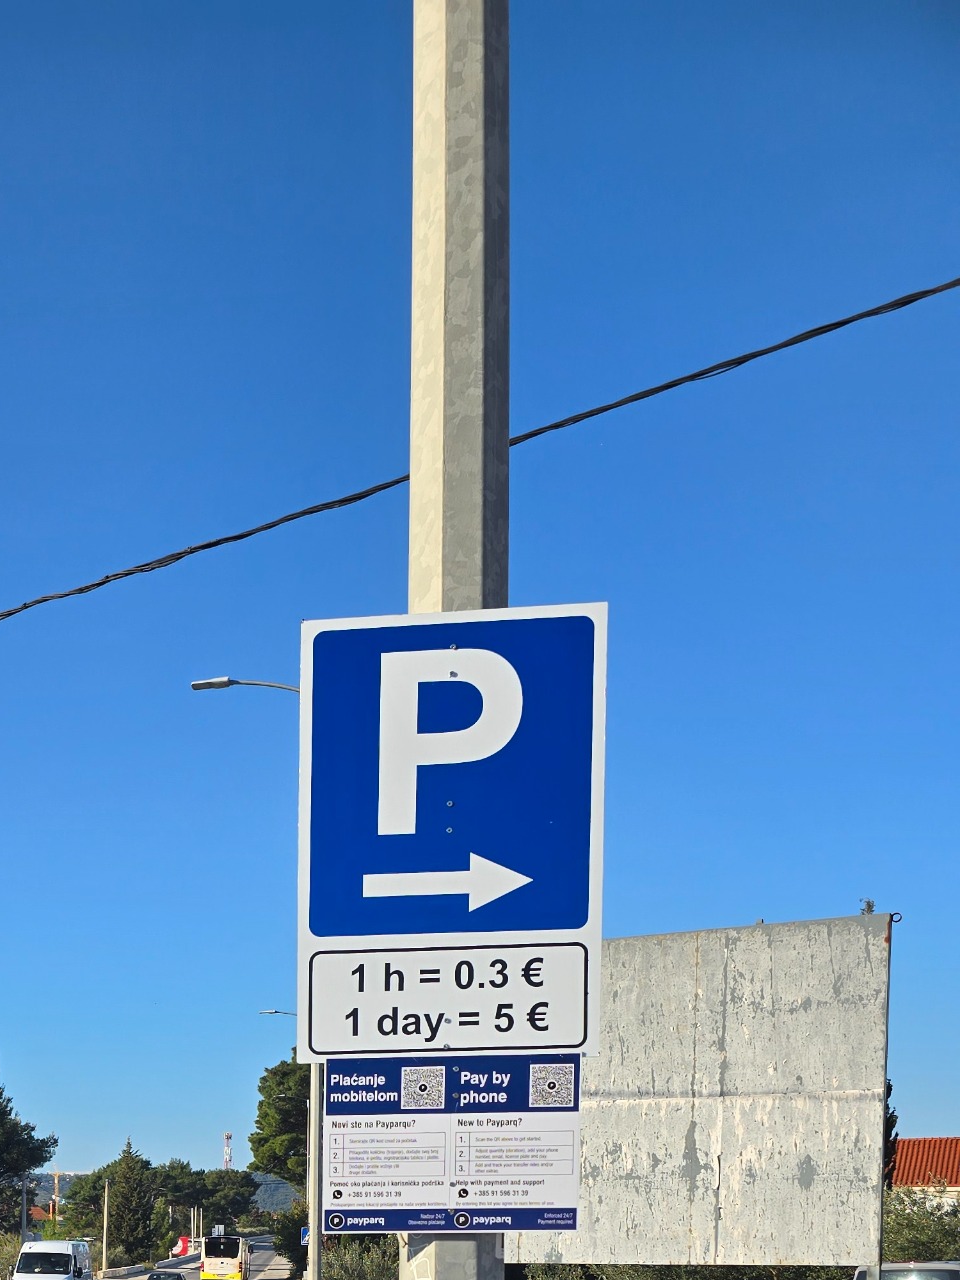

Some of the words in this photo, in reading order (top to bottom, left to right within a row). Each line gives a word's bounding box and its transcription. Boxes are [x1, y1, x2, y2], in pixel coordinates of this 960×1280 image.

[378, 648, 524, 835] P
[352, 964, 365, 992] 1
[385, 962, 404, 992] h
[420, 968, 440, 984] =
[454, 959, 508, 990] 0.3
[521, 958, 544, 987] €
[345, 1007, 359, 1036] 1
[377, 1006, 445, 1042] day
[458, 1012, 480, 1026] =
[494, 1004, 514, 1032] 5
[526, 1002, 549, 1031] €
[330, 1074, 386, 1088] Plaćanje
[460, 1072, 488, 1088] Pay
[492, 1071, 510, 1086] by
[330, 1090, 398, 1102] mobitelom
[460, 1090, 508, 1106] phone
[332, 1120, 348, 1128] Novi
[351, 1120, 362, 1128] ste
[376, 1120, 416, 1130] Payparqu?
[458, 1118, 474, 1126] New
[476, 1118, 484, 1126] to
[486, 1118, 522, 1128] Payparq?
[347, 1217, 385, 1226] payparq
[473, 1216, 511, 1225] payparq
